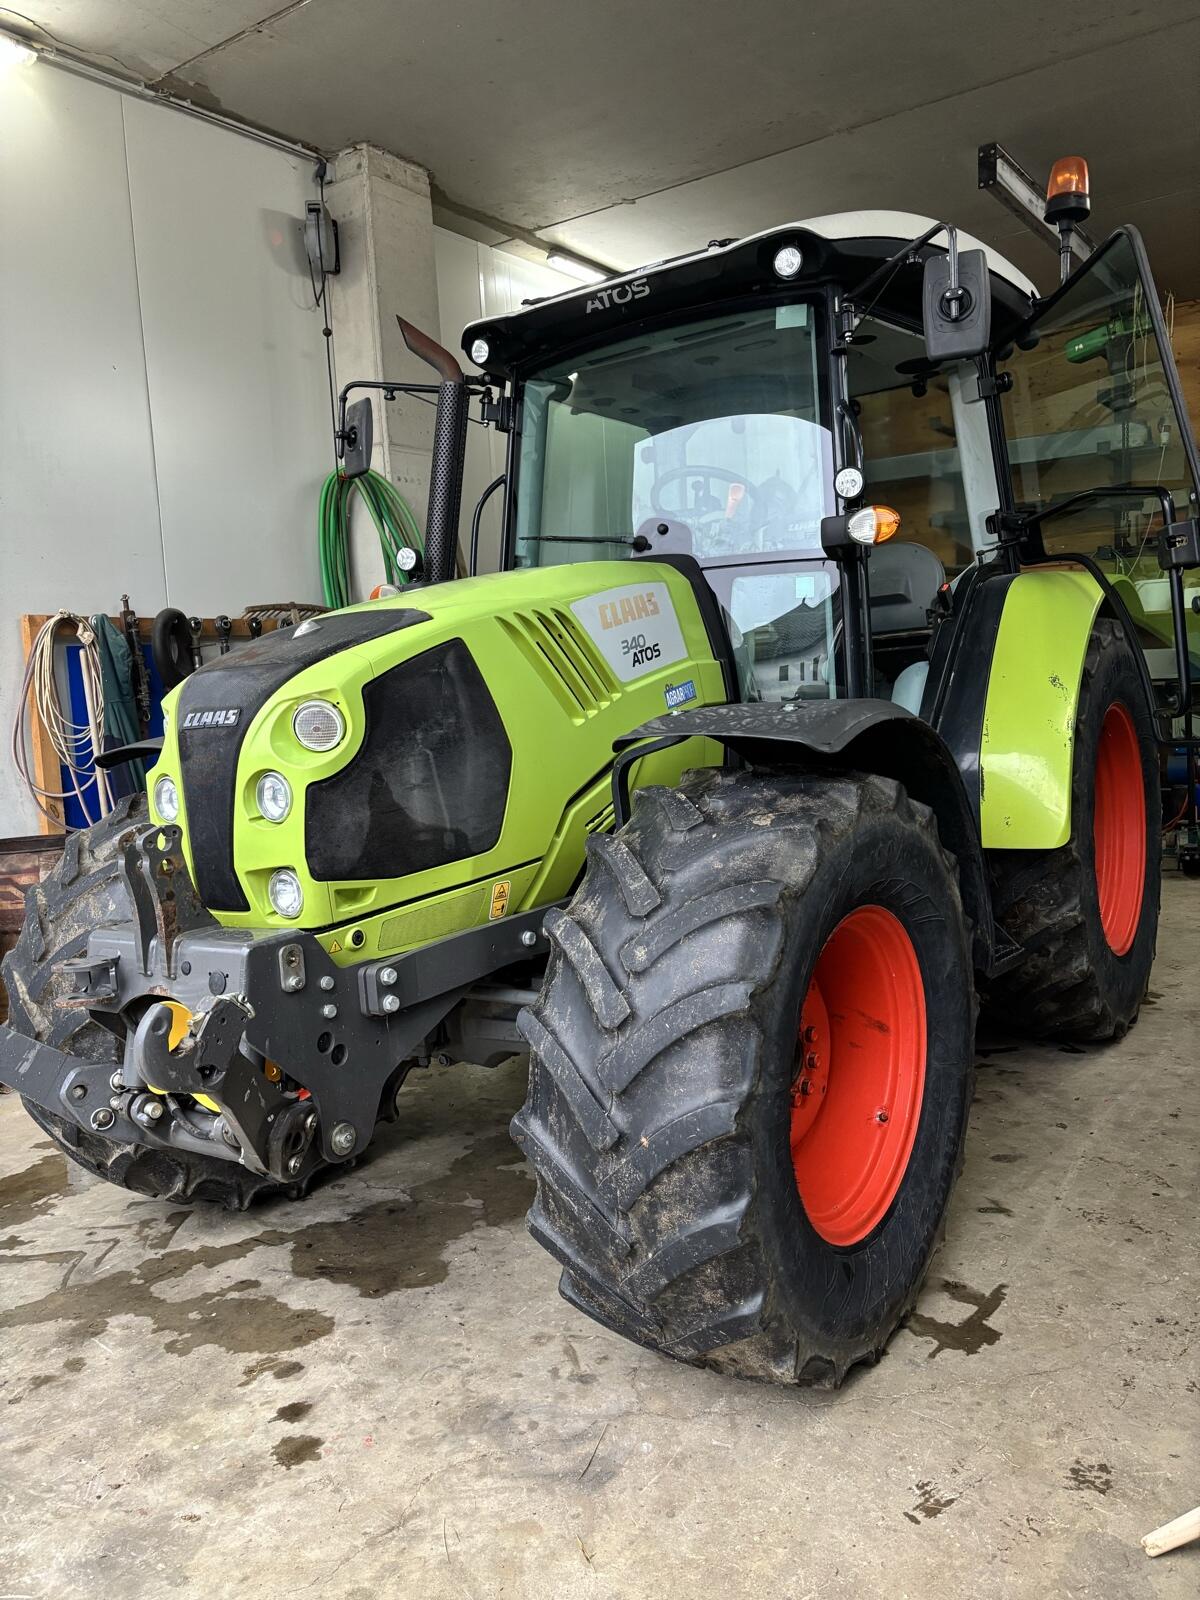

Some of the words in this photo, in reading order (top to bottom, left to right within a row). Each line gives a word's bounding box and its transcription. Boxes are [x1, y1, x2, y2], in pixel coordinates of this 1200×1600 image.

[585, 277, 651, 314] ATOS
[598, 591, 660, 630] CLAAS
[621, 633, 646, 656] 340
[632, 643, 661, 668] ATOS
[183, 708, 239, 728] CLAAS
